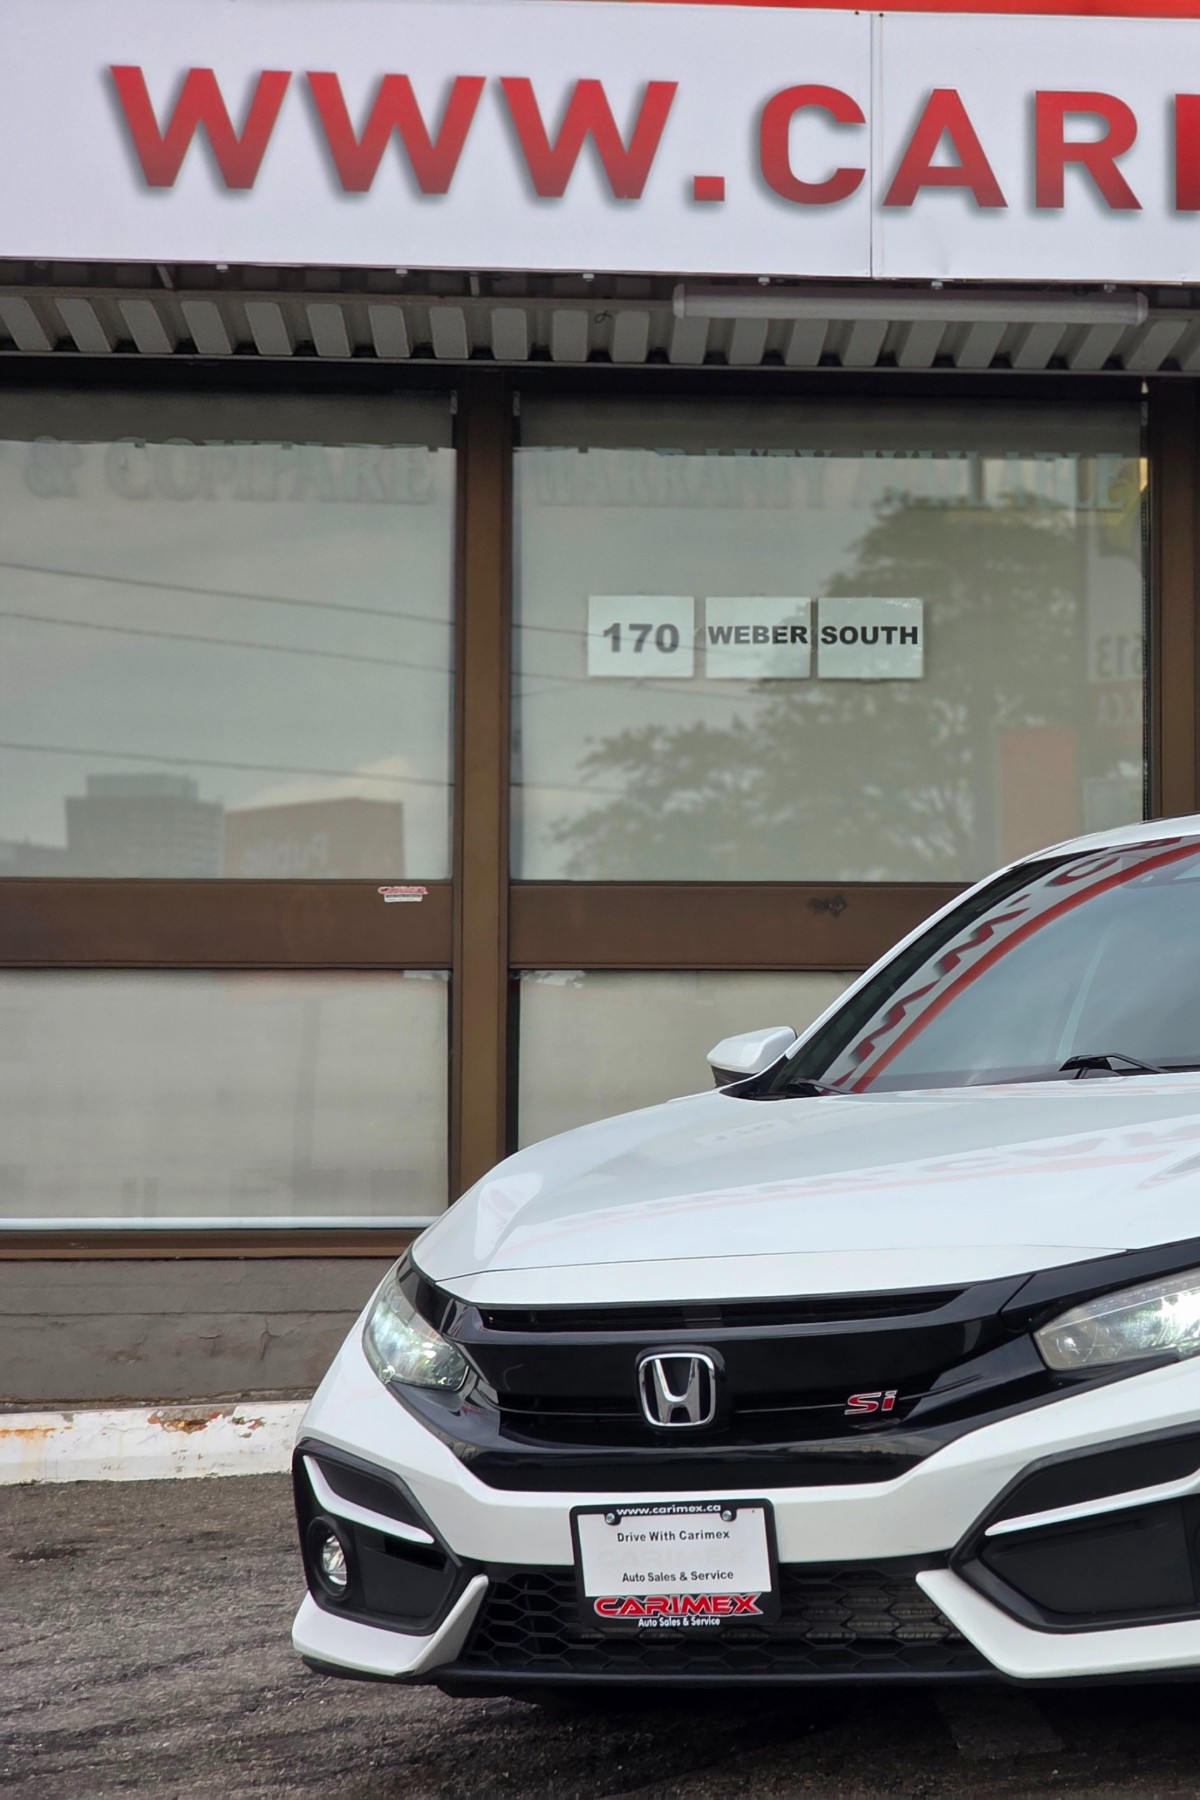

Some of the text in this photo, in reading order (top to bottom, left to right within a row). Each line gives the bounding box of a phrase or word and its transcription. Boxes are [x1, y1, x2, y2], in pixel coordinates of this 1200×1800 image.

[602, 622, 919, 654] 170 WEBER SOUTH
[843, 1389, 898, 1415] Si
[616, 1504, 722, 1516] www.carimex.ca
[616, 1529, 731, 1542] Drive With Carimex
[622, 1569, 734, 1582] Auto Sales & Service
[593, 1592, 764, 1619] CARIMEX
[638, 1616, 721, 1628] Auto Sales & Service
